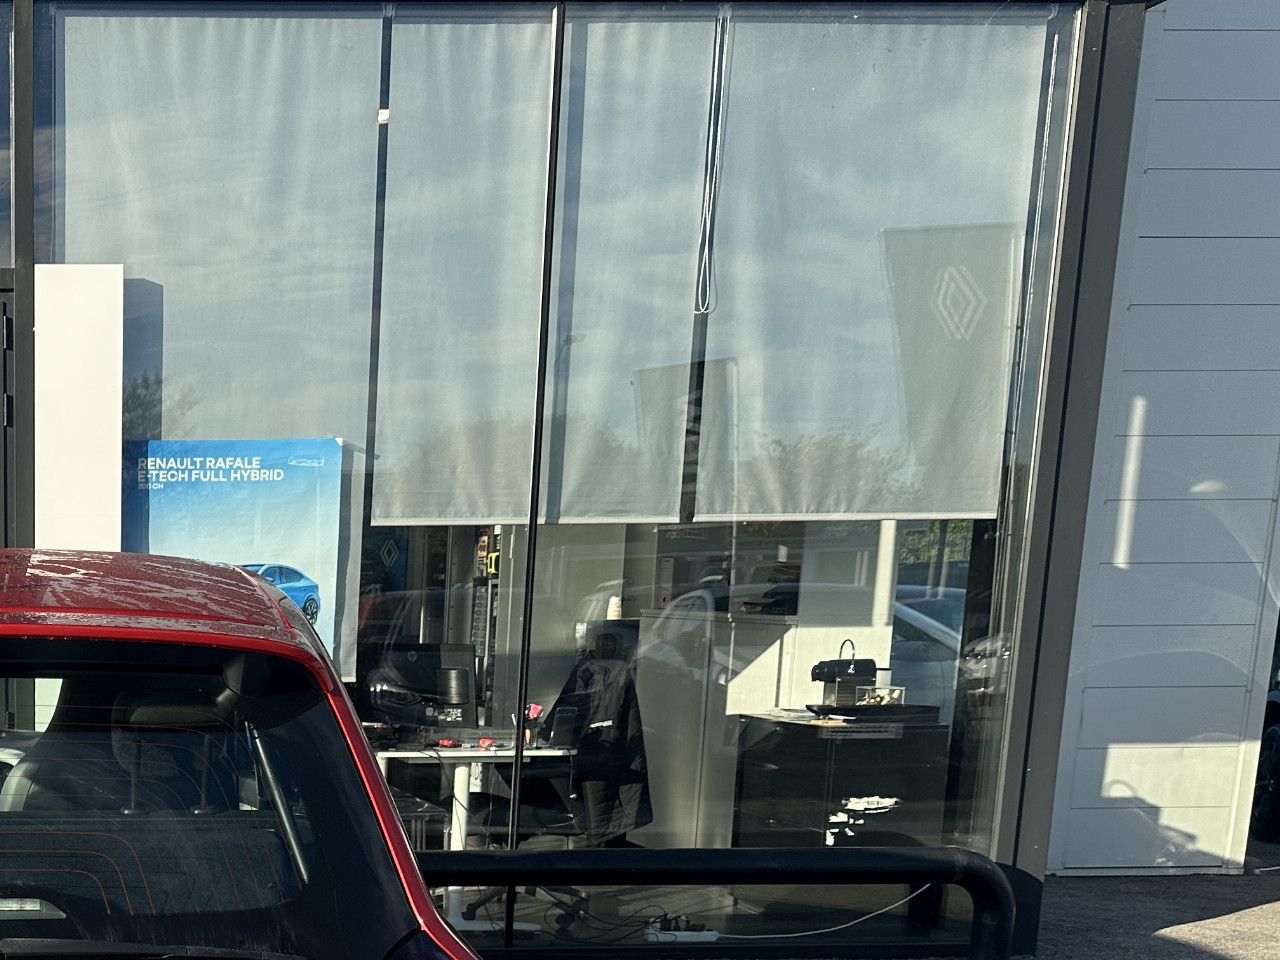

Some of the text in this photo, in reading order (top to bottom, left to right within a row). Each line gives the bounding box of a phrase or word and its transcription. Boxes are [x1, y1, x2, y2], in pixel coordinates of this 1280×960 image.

[137, 457, 261, 470] RENAULT RAFALE
[137, 469, 285, 482] E-TECH FULL HYBRID
